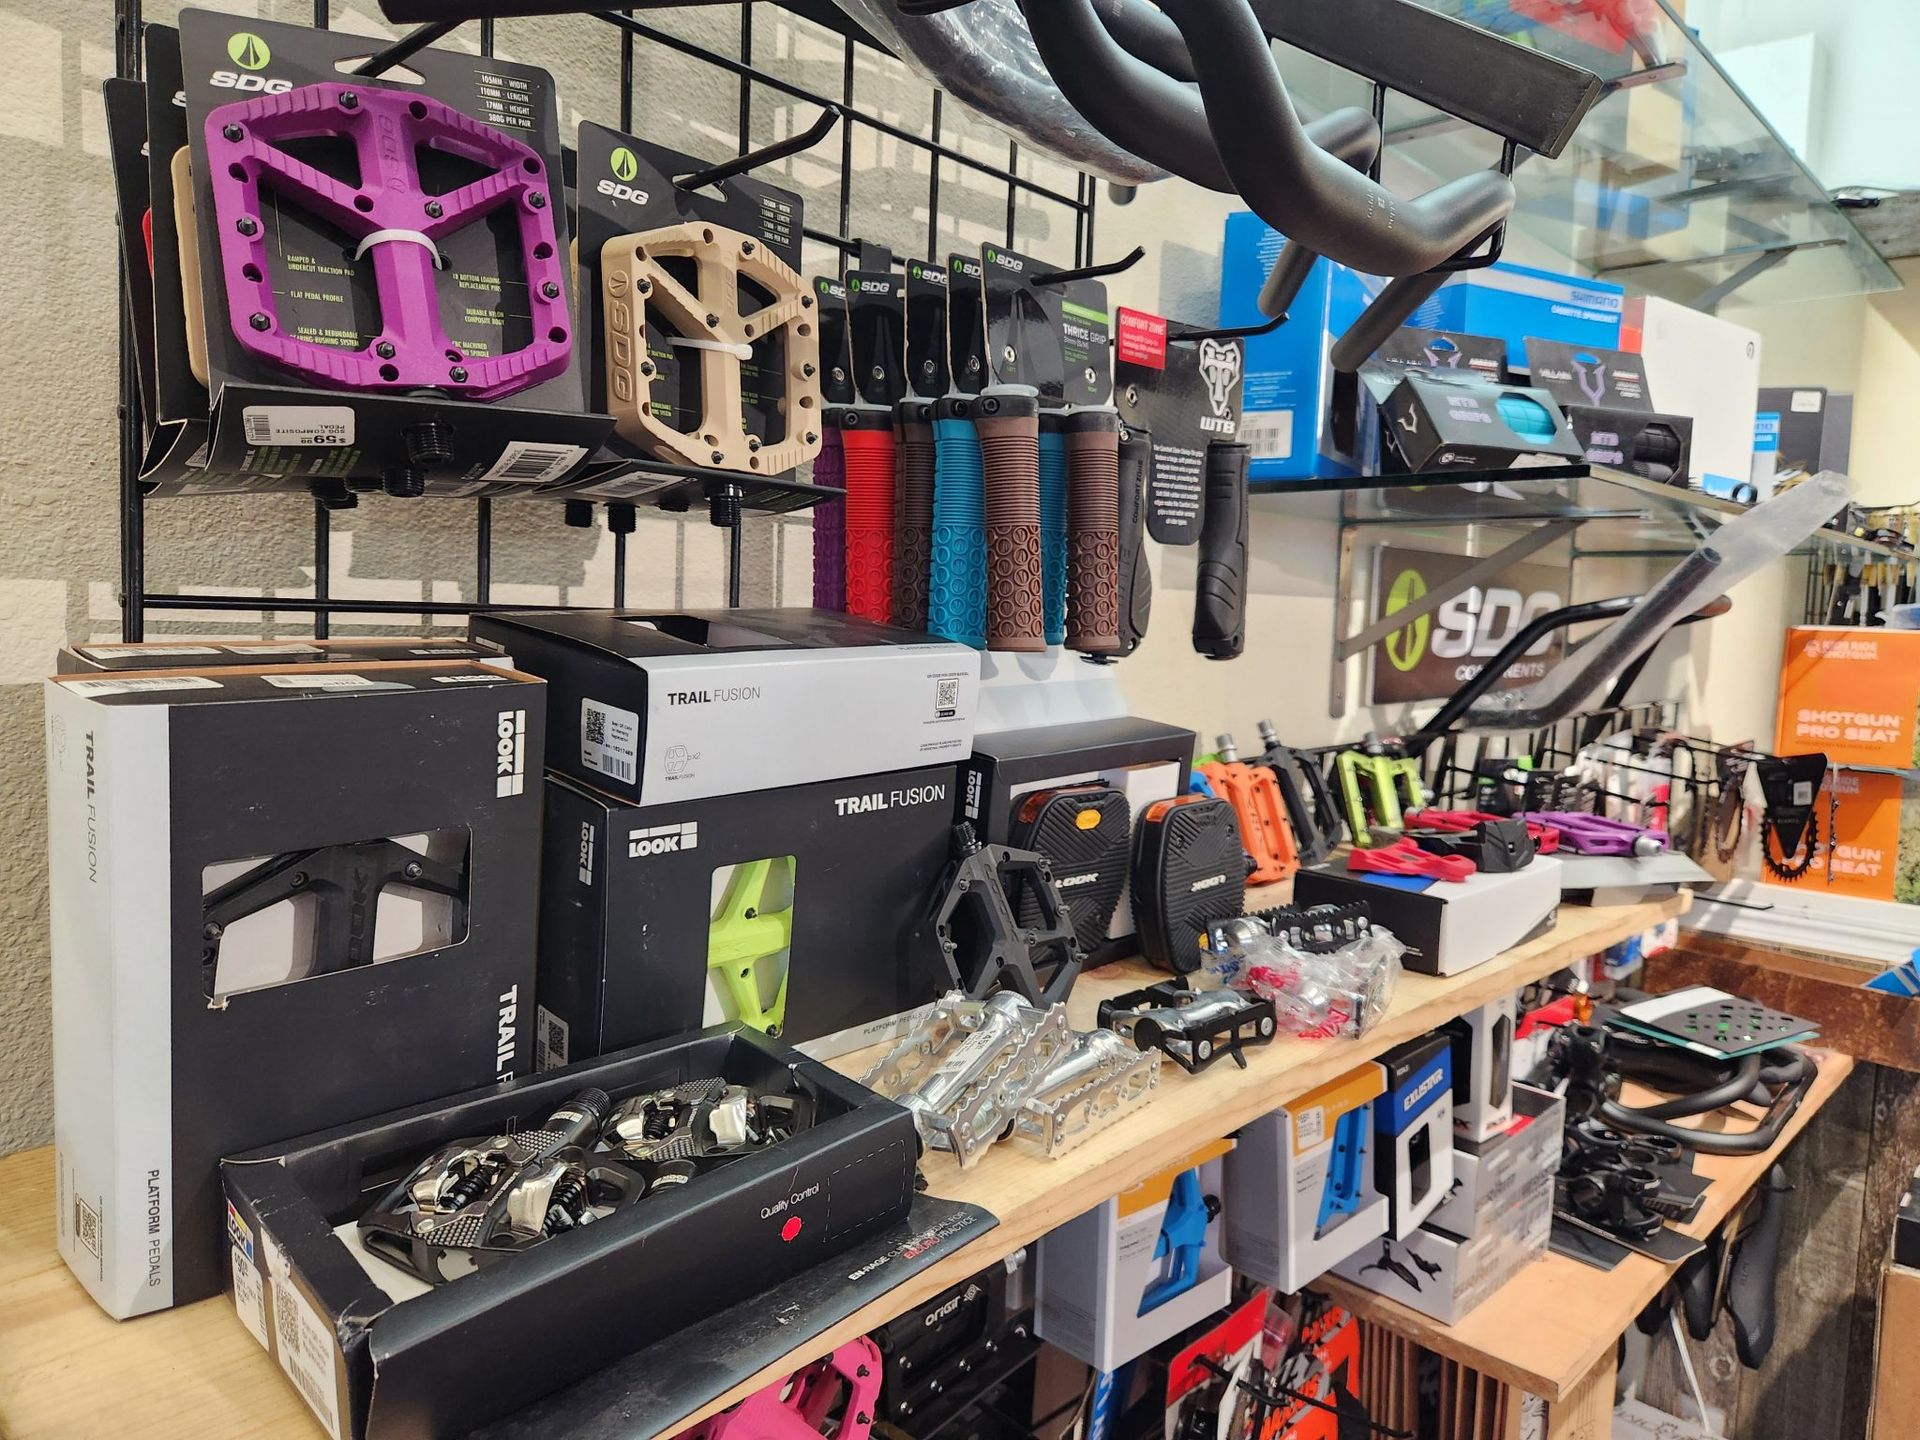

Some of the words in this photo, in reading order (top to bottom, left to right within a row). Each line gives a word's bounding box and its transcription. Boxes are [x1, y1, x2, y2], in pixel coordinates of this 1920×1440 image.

[210, 70, 294, 95] SDG
[508, 79, 528, 91] WIDTH
[506, 91, 529, 103] LENGTH
[509, 104, 530, 115] HEIGHT
[505, 116, 517, 125] PER
[518, 118, 532, 128] PAIR
[597, 179, 650, 205] SDG
[318, 265, 343, 276] TRACTION
[344, 268, 355, 277] PAD
[963, 264, 981, 277] SD
[996, 254, 1024, 272] SDG
[290, 290, 303, 299] FLAT
[304, 291, 322, 301] PEDAL
[322, 293, 344, 303] PROFILE
[829, 285, 846, 299] SD
[860, 281, 889, 293] SDG
[1570, 290, 1619, 308] SHIMANO
[1062, 323, 1089, 341] THRICE
[1089, 331, 1107, 345] GRIP
[611, 301, 634, 402] SDG
[667, 691, 711, 706] TRAIL
[713, 686, 761, 703] FUSION
[1797, 709, 1900, 728] SHOTGUN
[497, 710, 513, 775] LOOK
[1796, 724, 1840, 739] PRO
[1843, 727, 1901, 743] SEAT
[84, 729, 96, 800] TRAIL
[964, 769, 978, 805] LOOK
[834, 792, 889, 817] TRAIL
[890, 783, 946, 809] FUSION
[87, 803, 97, 884] FUSION
[578, 821, 590, 865] LOOK
[628, 836, 682, 859] LOOK
[1055, 872, 1099, 889] LOOK
[1191, 874, 1227, 892] LOOK
[496, 984, 517, 1072] TRAIL
[863, 1019, 897, 1036] PLATFORM
[1403, 1067, 1444, 1112] EXUSTAR
[147, 1168, 161, 1233] PLATFORM
[760, 1199, 789, 1219] Quality
[790, 1182, 820, 1204] Control
[228, 1217, 247, 1248] LOOK
[938, 1214, 977, 1240] PRACTICE
[150, 1238, 162, 1288] PEDALS
[847, 1255, 890, 1280] EN-RAGE
